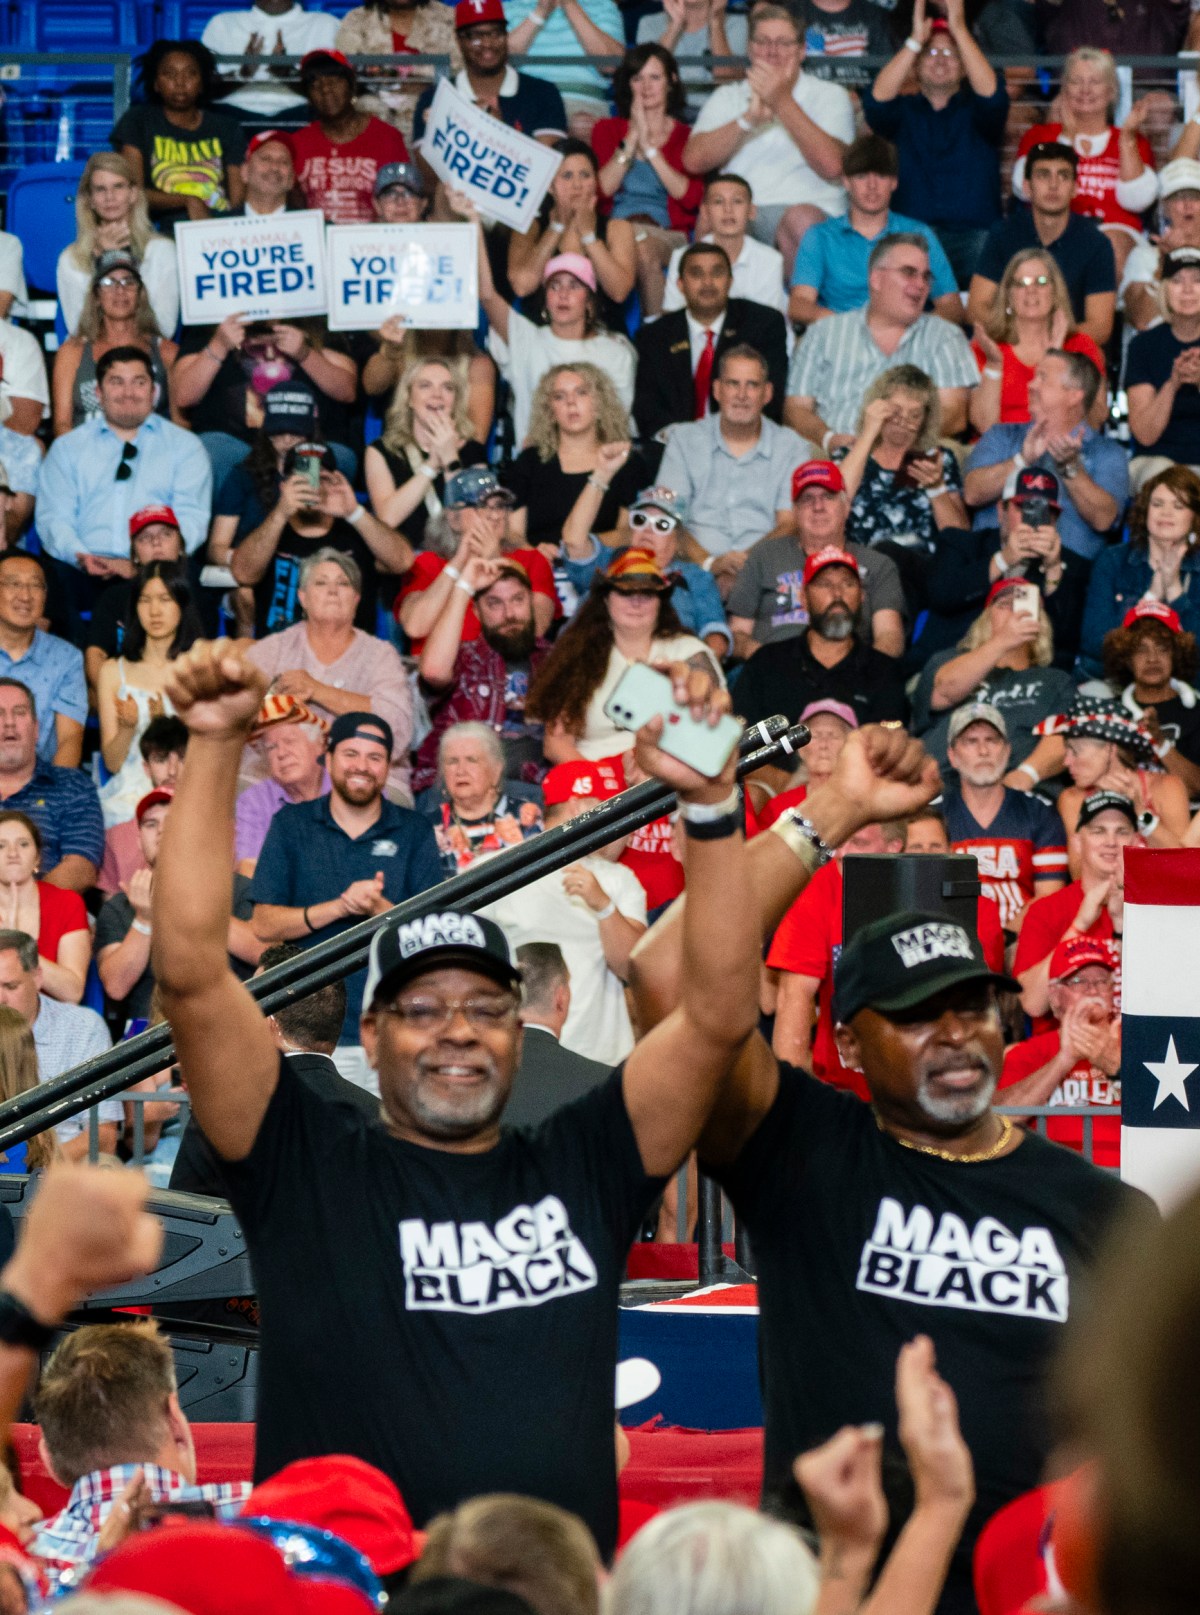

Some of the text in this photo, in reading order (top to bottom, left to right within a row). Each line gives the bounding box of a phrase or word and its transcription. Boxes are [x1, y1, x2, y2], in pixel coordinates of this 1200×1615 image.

[445, 116, 530, 182] YOU'RE
[299, 156, 378, 180] JESUS
[432, 128, 529, 208] FIRED!
[202, 244, 304, 270] YOU'RE
[195, 265, 315, 300] FIRED!
[572, 776, 593, 795] 45
[957, 845, 1020, 879] SA
[398, 912, 484, 942] MAGA
[403, 929, 483, 955] BLACK
[896, 925, 968, 951] MAGA
[901, 938, 976, 968] BLACK
[399, 1194, 572, 1268] MAGA
[871, 1197, 1066, 1276] MAGA
[410, 1245, 592, 1308] BLACK
[863, 1249, 1061, 1316] BLACK
